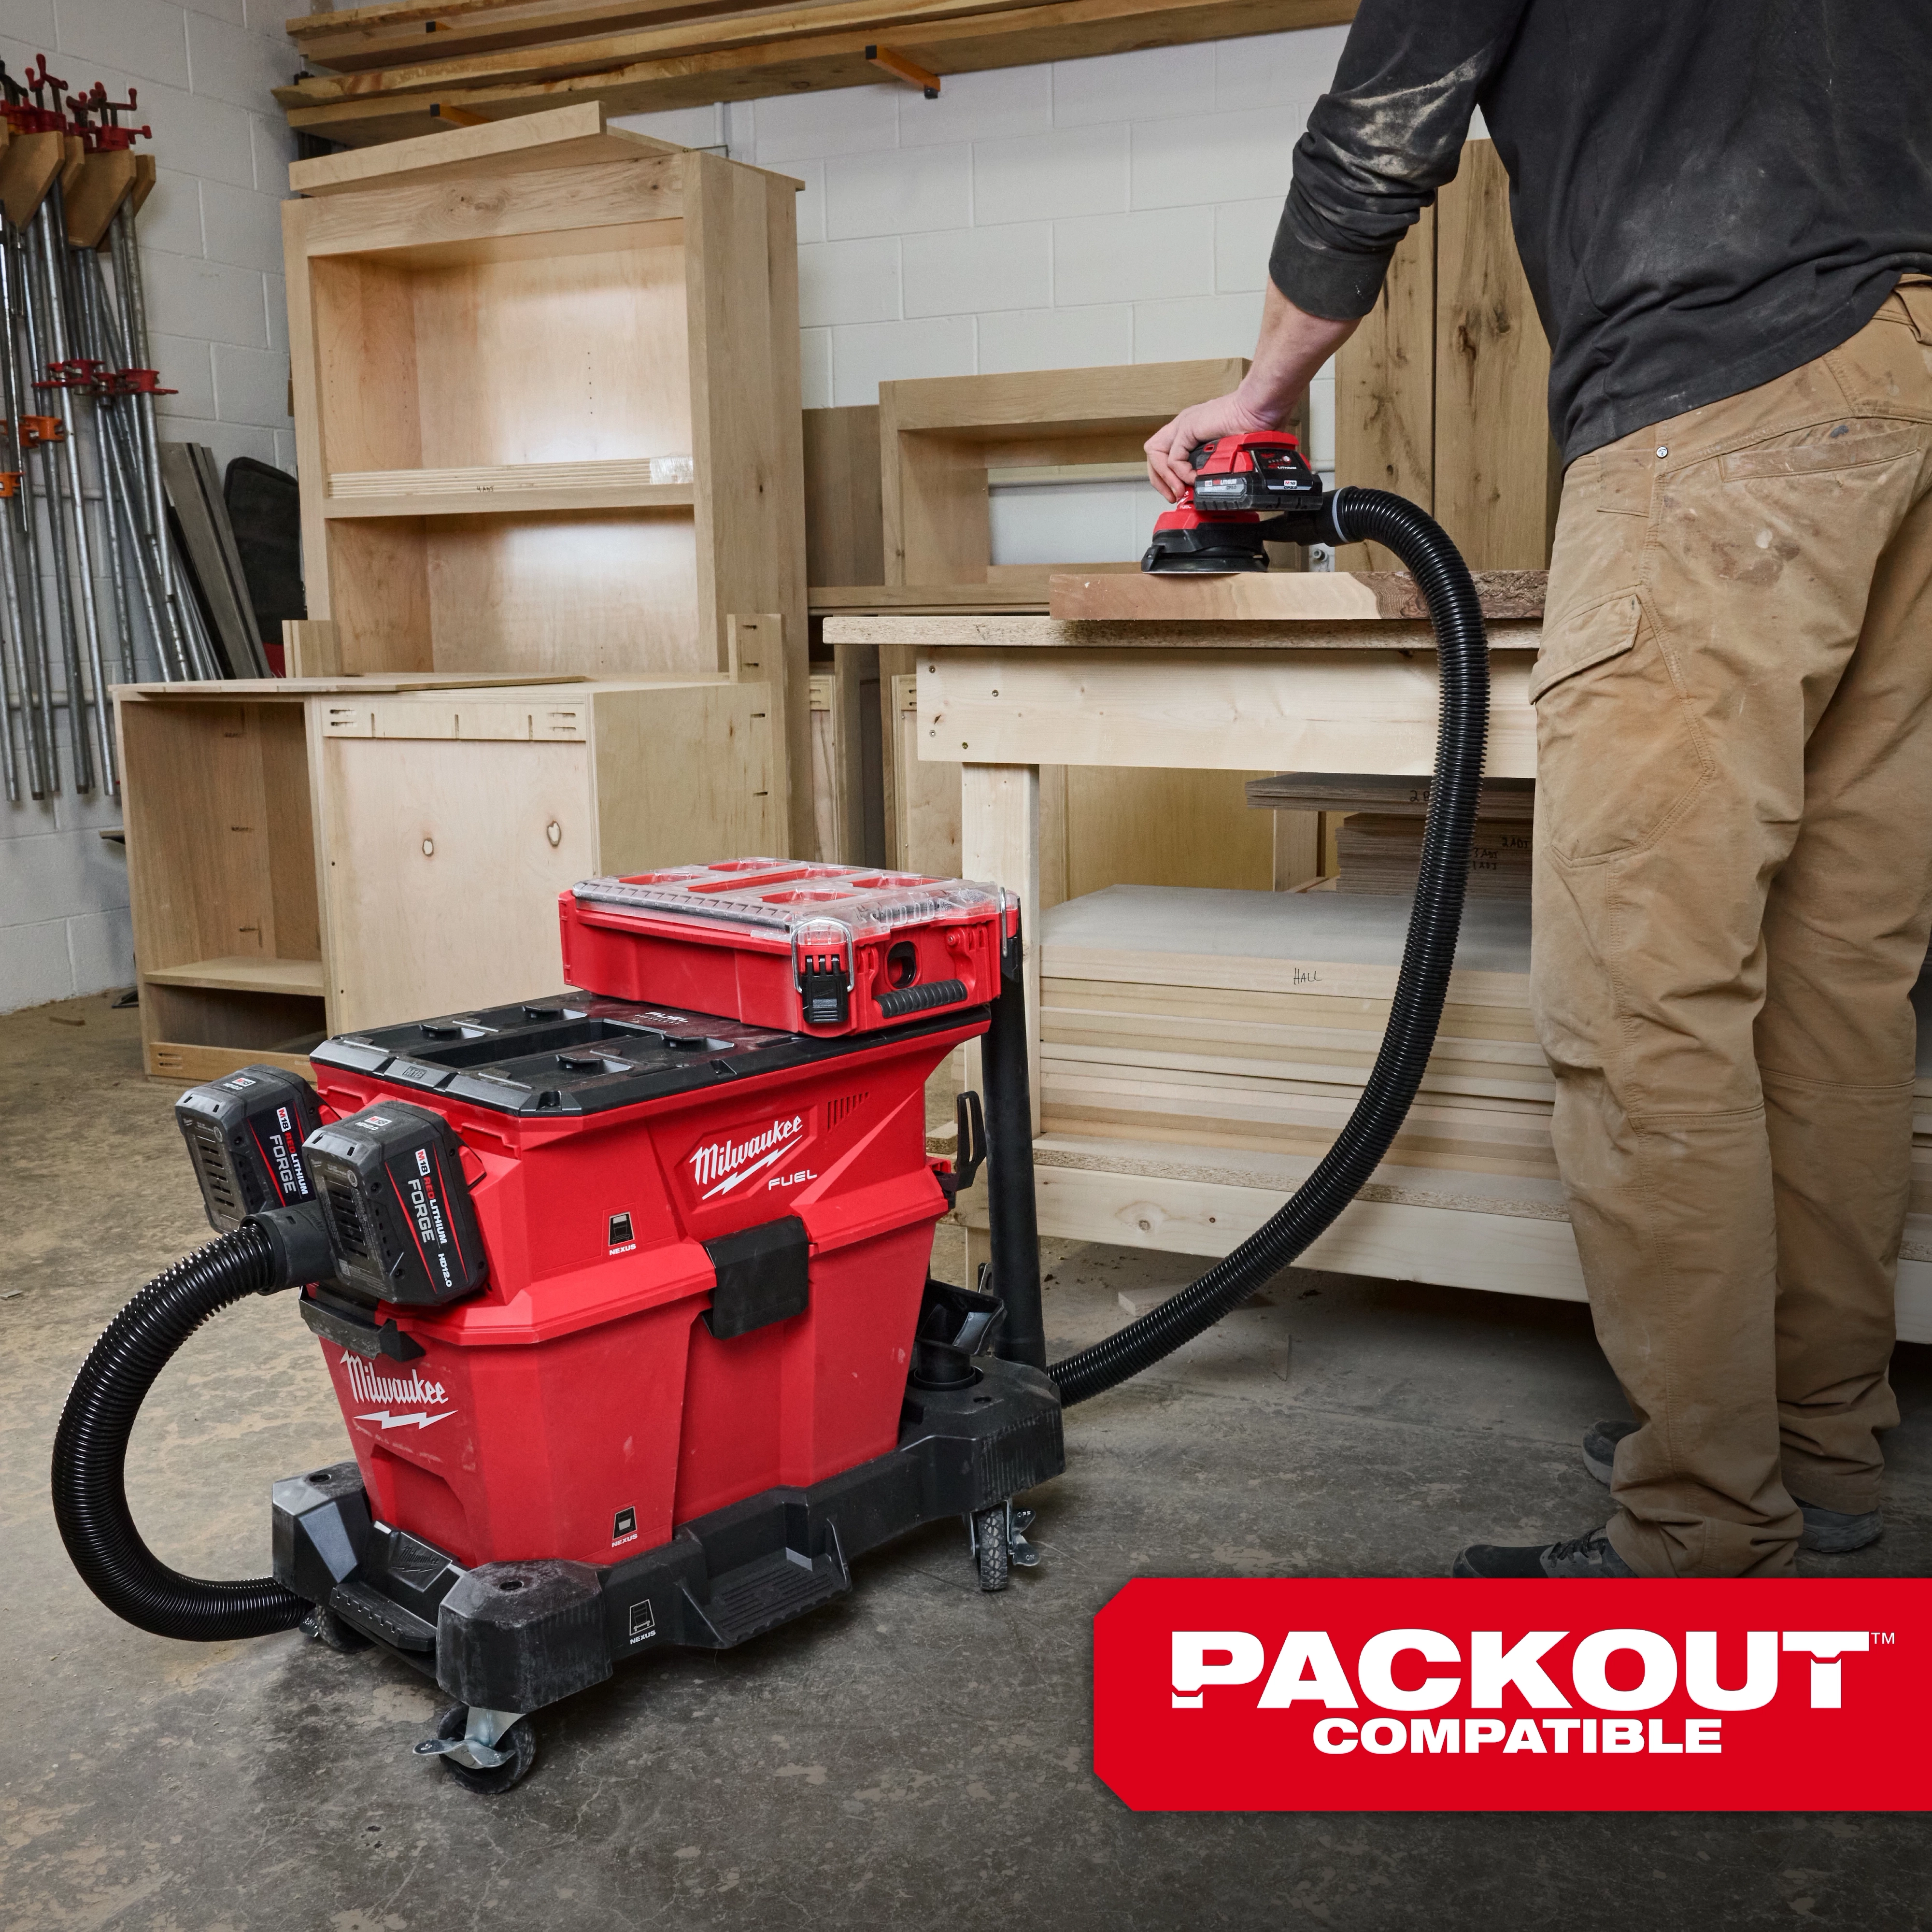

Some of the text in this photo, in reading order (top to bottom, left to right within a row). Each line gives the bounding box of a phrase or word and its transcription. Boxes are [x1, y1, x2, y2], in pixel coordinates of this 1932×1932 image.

[1410, 790, 1419, 801] 2
[1293, 967, 1322, 985] HALL
[645, 1012, 688, 1023] FUEL
[402, 1066, 427, 1079] M18
[279, 1109, 309, 1195] M18 REDLITHIUM
[689, 1116, 803, 1185] Milwaukee
[270, 1135, 297, 1193] FORGE
[768, 1169, 817, 1191] FUEL
[408, 1179, 435, 1243] FORGE
[417, 1151, 453, 1287] M18 REDLITHIUM HD12.0
[609, 1243, 637, 1256] NEXUS
[340, 1349, 449, 1405] Milwaukee
[611, 1534, 638, 1548] NEXUS
[398, 1545, 439, 1565] Milwaukee
[630, 1630, 656, 1645] NEXUS
